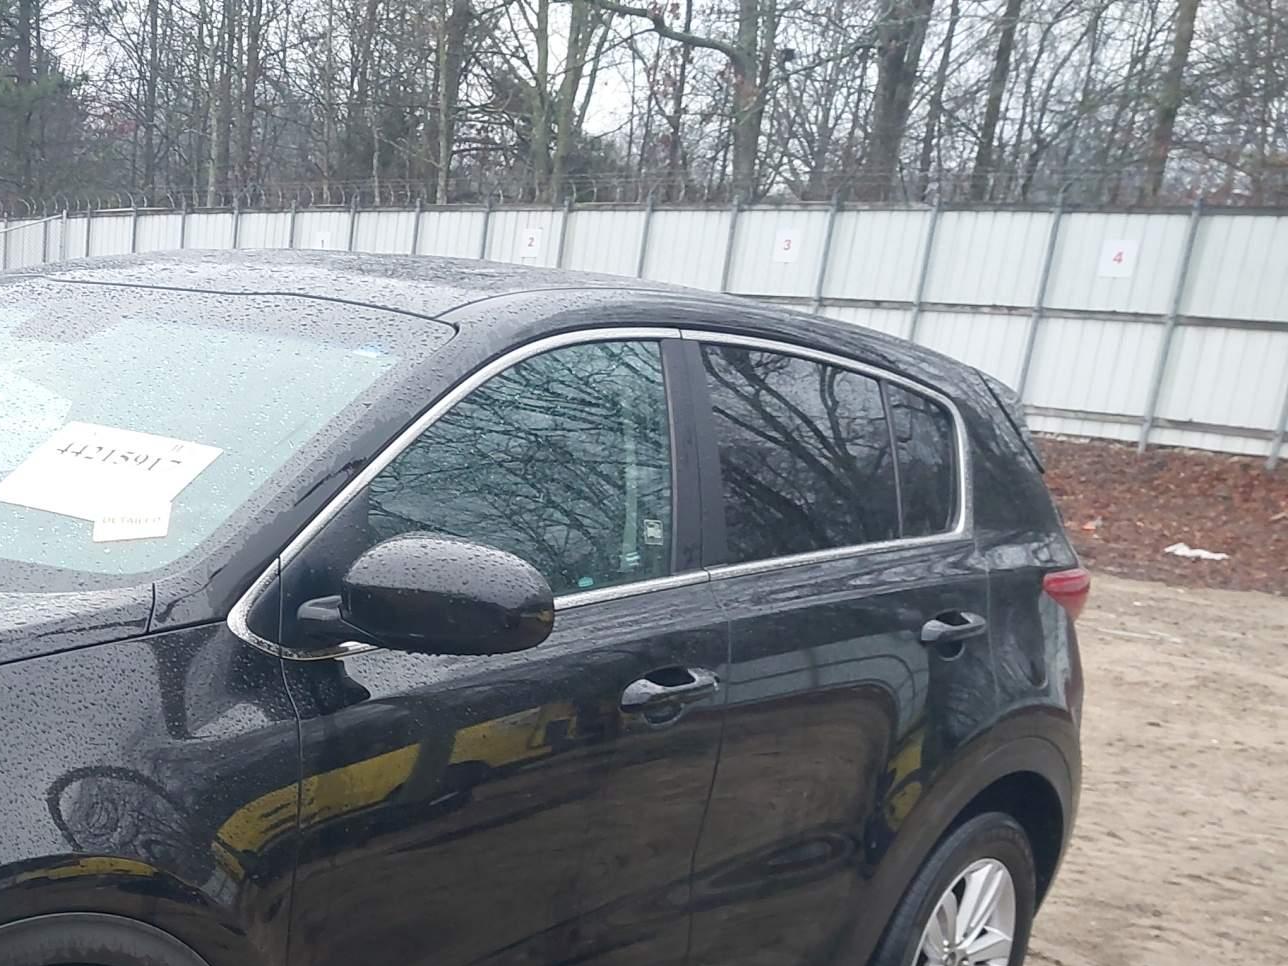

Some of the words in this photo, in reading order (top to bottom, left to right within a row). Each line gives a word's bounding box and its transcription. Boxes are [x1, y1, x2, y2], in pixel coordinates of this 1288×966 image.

[527, 236, 535, 247] 2
[783, 239, 792, 251] 3
[1112, 251, 1124, 264] 4
